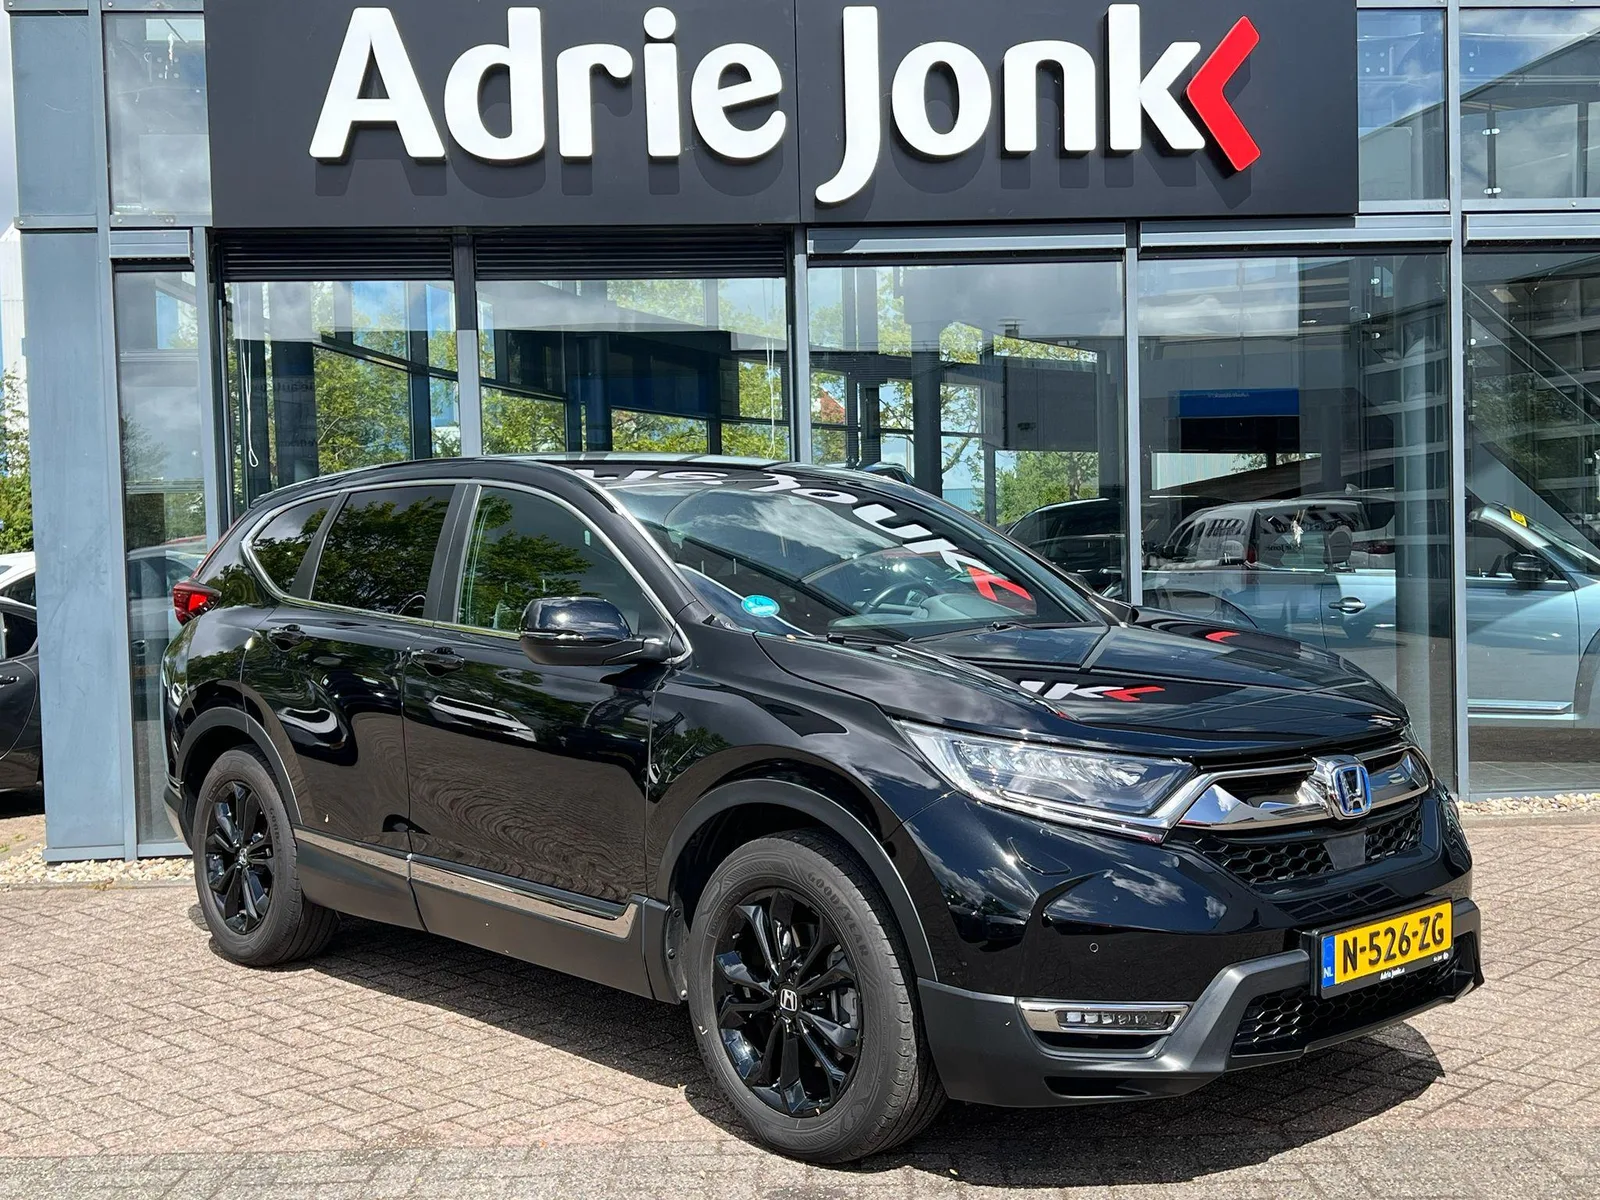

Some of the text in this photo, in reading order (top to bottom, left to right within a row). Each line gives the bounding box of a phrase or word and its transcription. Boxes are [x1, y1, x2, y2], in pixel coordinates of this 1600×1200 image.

[308, 3, 1206, 203] Adrie Jonk
[807, 871, 869, 957] GOODYEAR
[1343, 912, 1445, 974] N-526-ZG
[1323, 967, 1334, 979] NL
